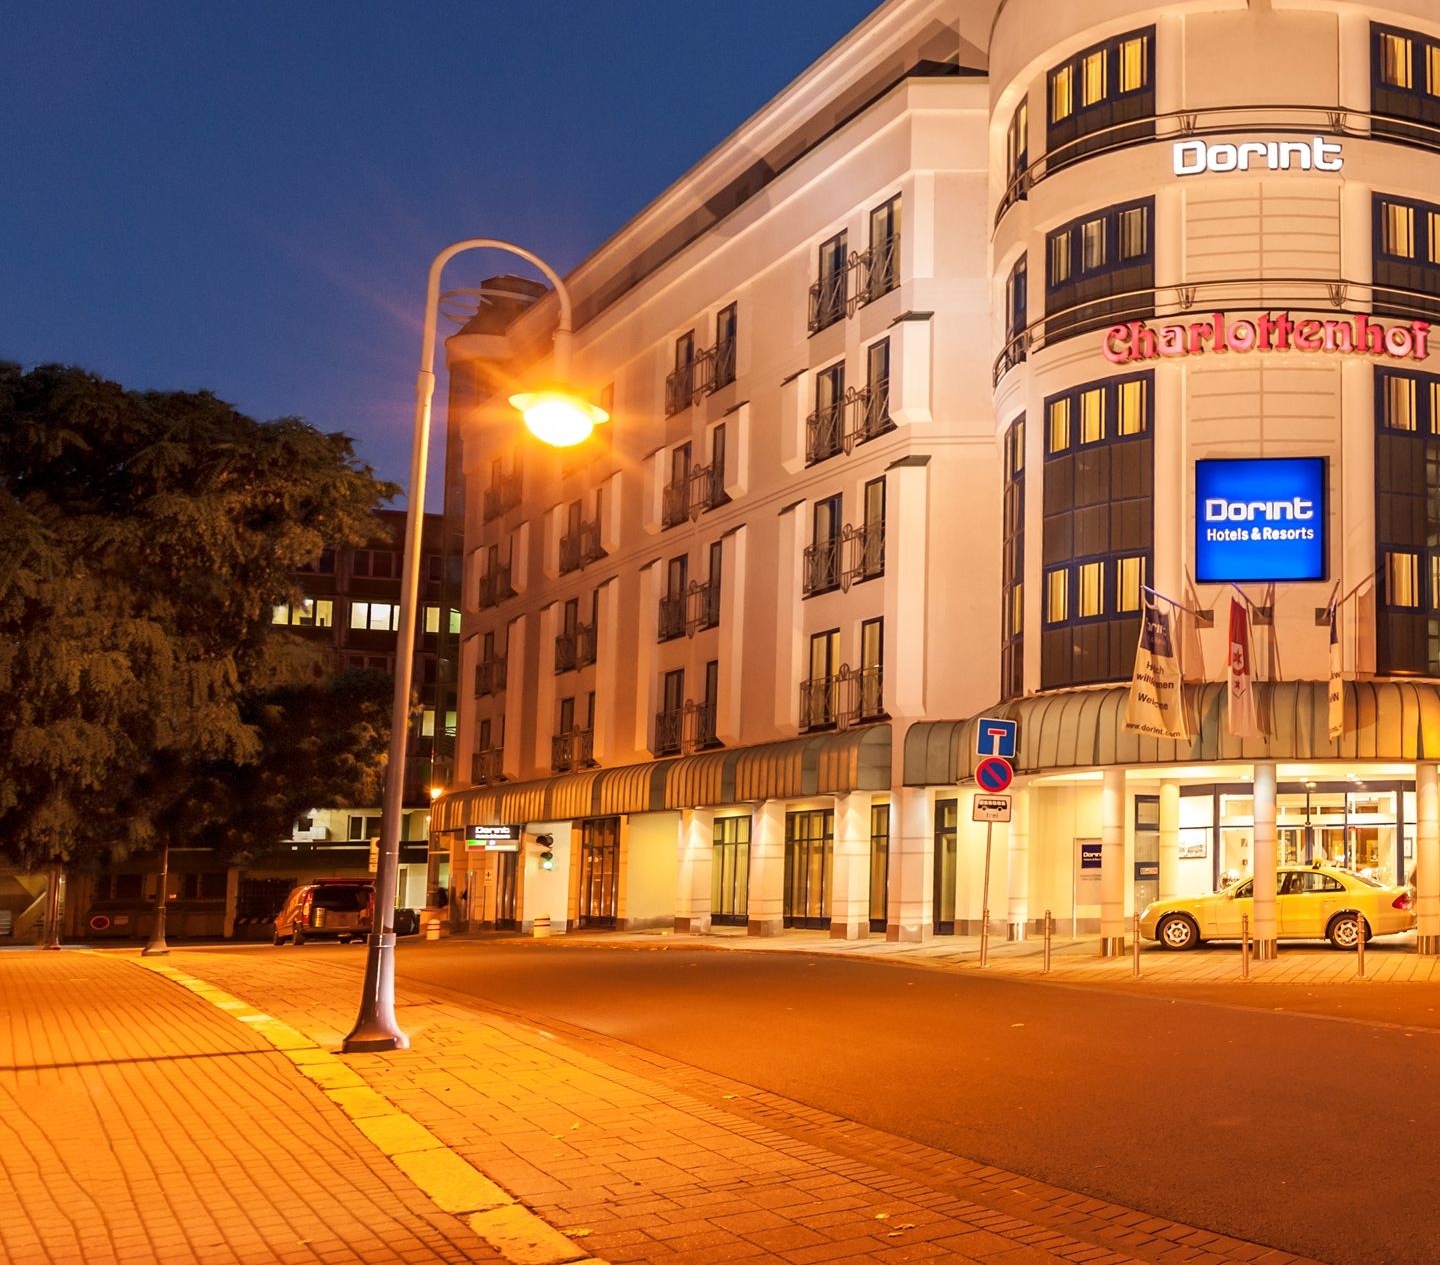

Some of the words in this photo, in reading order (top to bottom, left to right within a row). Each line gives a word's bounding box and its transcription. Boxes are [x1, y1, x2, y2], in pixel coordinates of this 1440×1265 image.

[1173, 136, 1343, 176] Dorint
[1102, 312, 1432, 363] Charlottenhof
[1206, 497, 1314, 521] Dorint
[1207, 528, 1249, 541] Hotels
[1251, 527, 1261, 540] &
[1263, 527, 1314, 540] Resorts
